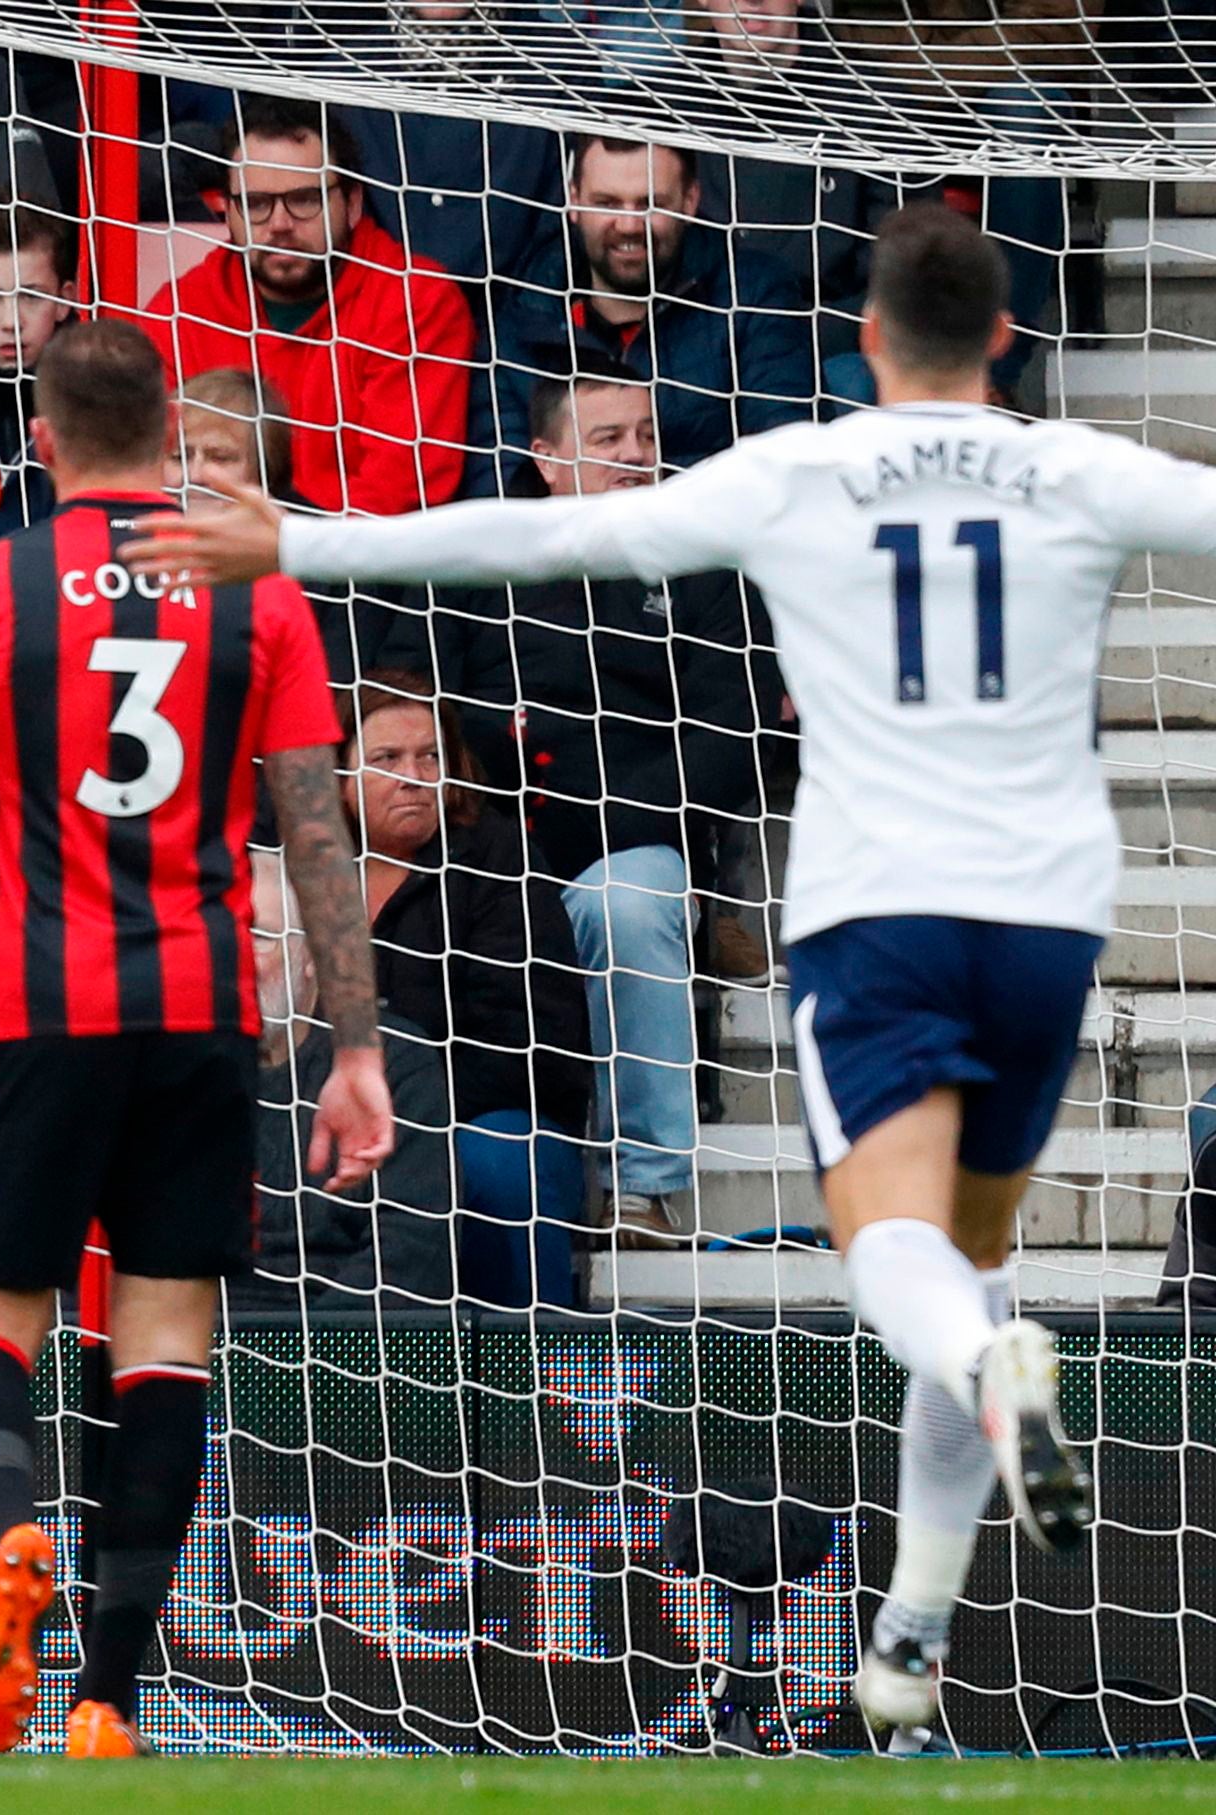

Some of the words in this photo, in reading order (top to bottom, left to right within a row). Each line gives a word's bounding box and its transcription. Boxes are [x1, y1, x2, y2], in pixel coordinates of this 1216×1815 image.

[839, 439, 1037, 506] LAMELA
[872, 519, 1004, 703] 11
[75, 637, 188, 818] 3
